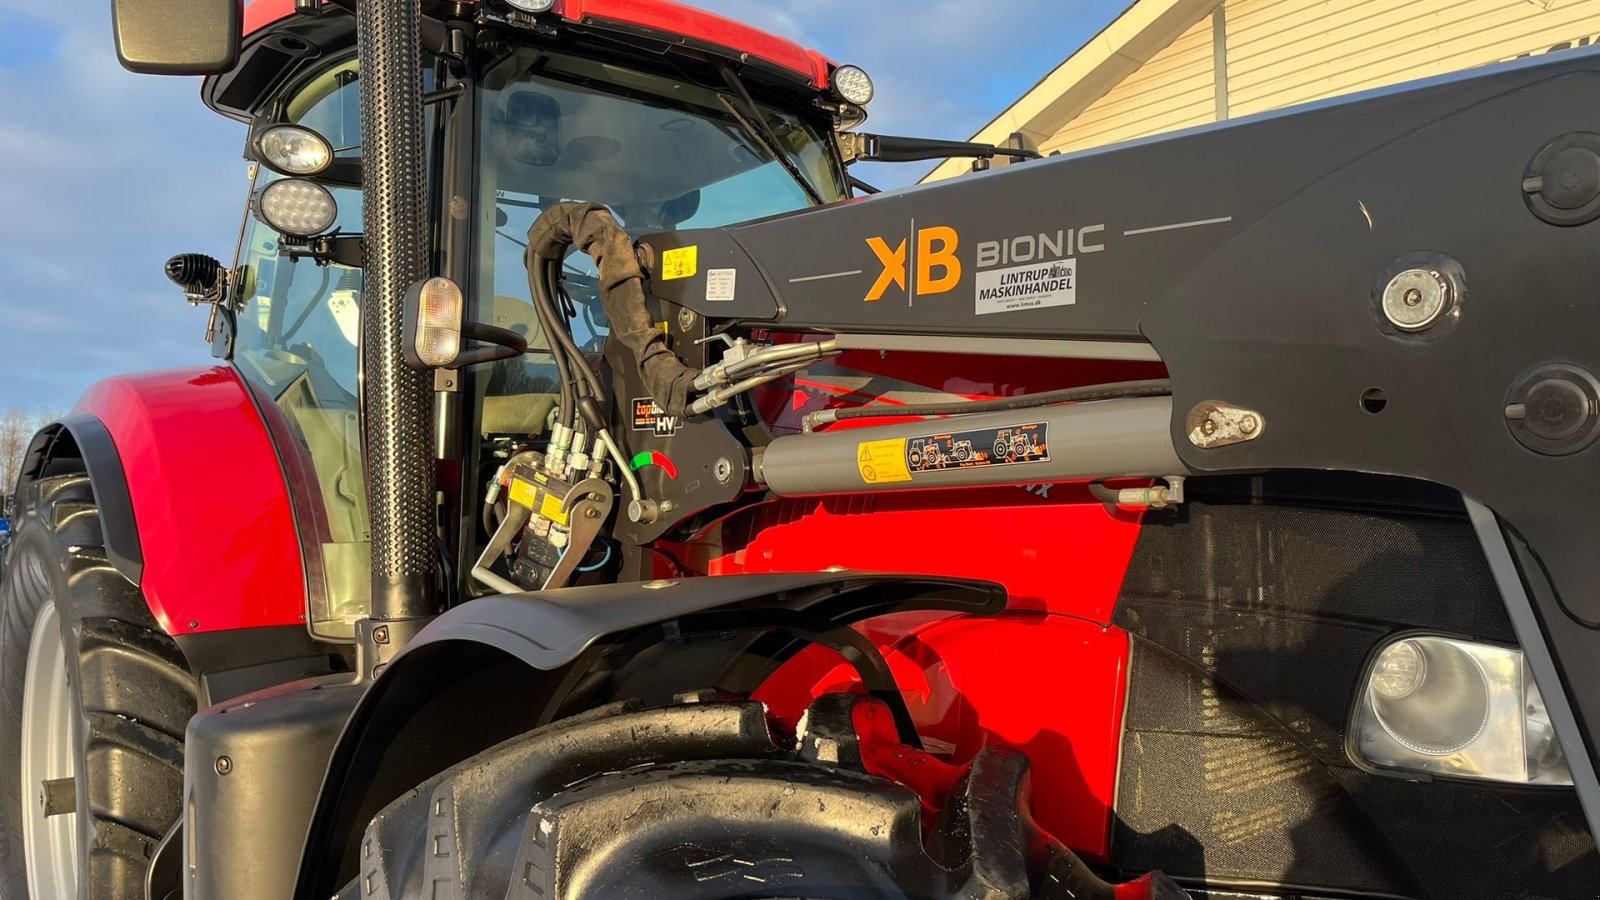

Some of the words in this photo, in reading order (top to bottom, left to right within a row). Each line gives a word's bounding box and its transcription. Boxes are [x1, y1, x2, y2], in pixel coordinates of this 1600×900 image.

[976, 224, 1105, 268] BIONIC
[1000, 268, 1049, 285] LINTRUP
[979, 278, 1073, 300] MASKINHANDEL
[656, 416, 674, 431] HV
